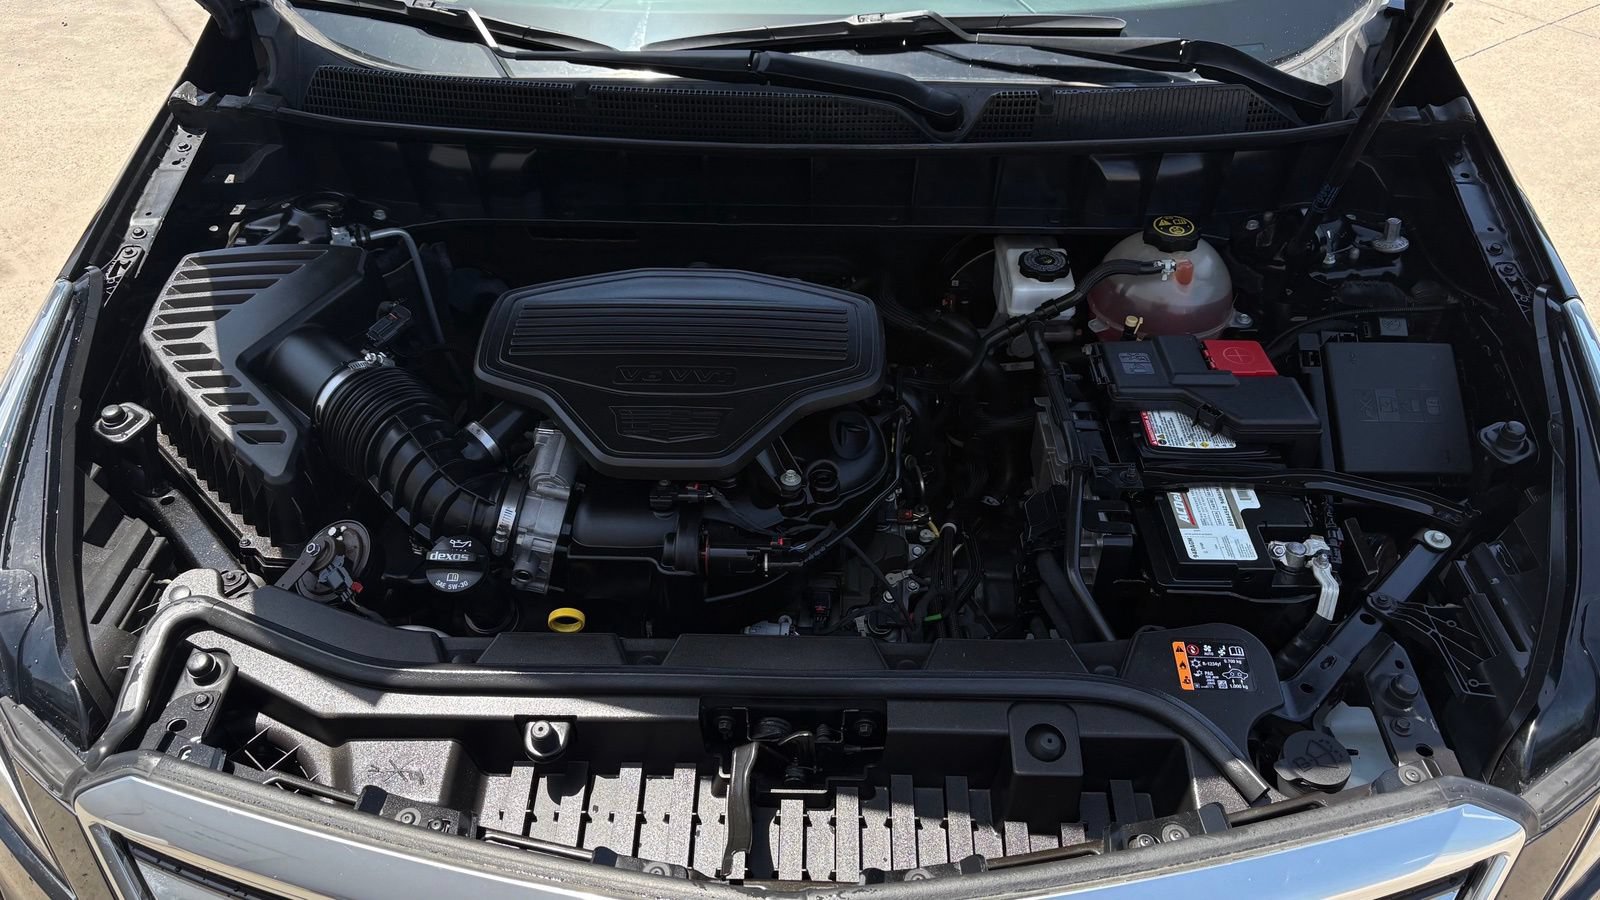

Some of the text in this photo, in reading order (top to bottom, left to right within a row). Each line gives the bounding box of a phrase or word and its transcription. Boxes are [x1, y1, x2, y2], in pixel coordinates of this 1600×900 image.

[1170, 492, 1191, 524] ACDel
[430, 551, 469, 560] dexos
[436, 580, 468, 590] SAE 5W-30
